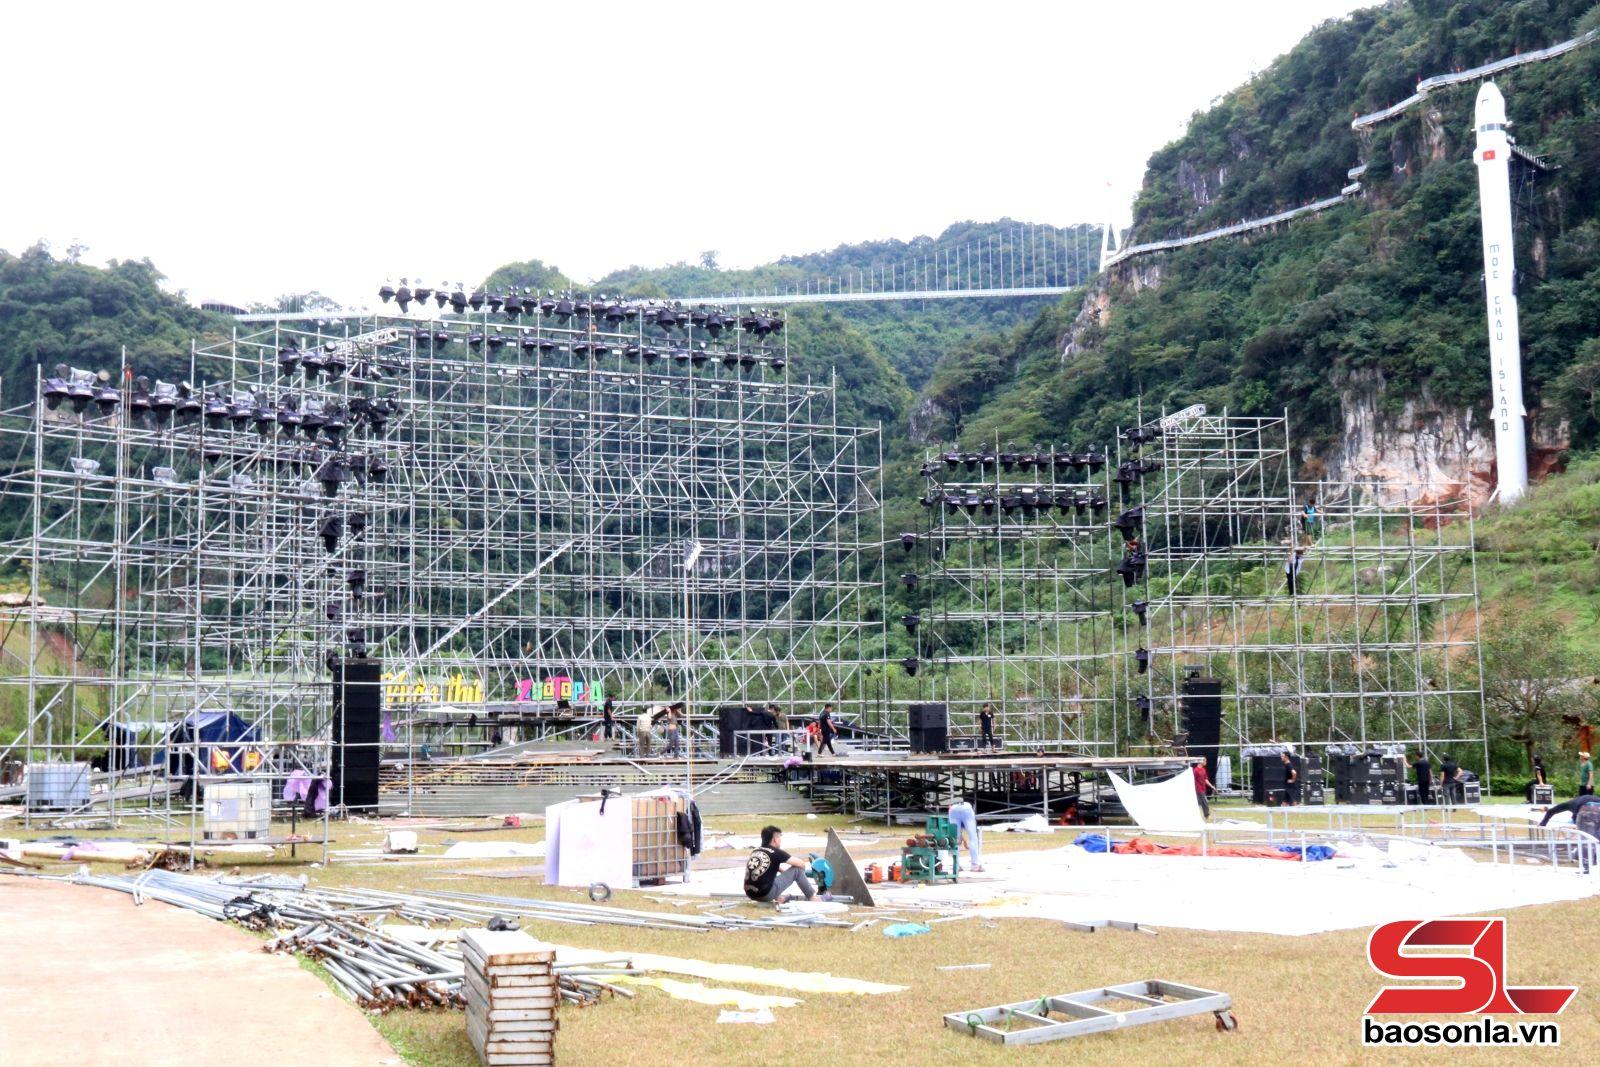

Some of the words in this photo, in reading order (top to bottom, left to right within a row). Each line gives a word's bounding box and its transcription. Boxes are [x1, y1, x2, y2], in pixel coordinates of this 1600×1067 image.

[1494, 295, 1503, 341] CHAU
[1498, 357, 1509, 431] ISLAND
[514, 675, 604, 706] ZOOTOPIA
